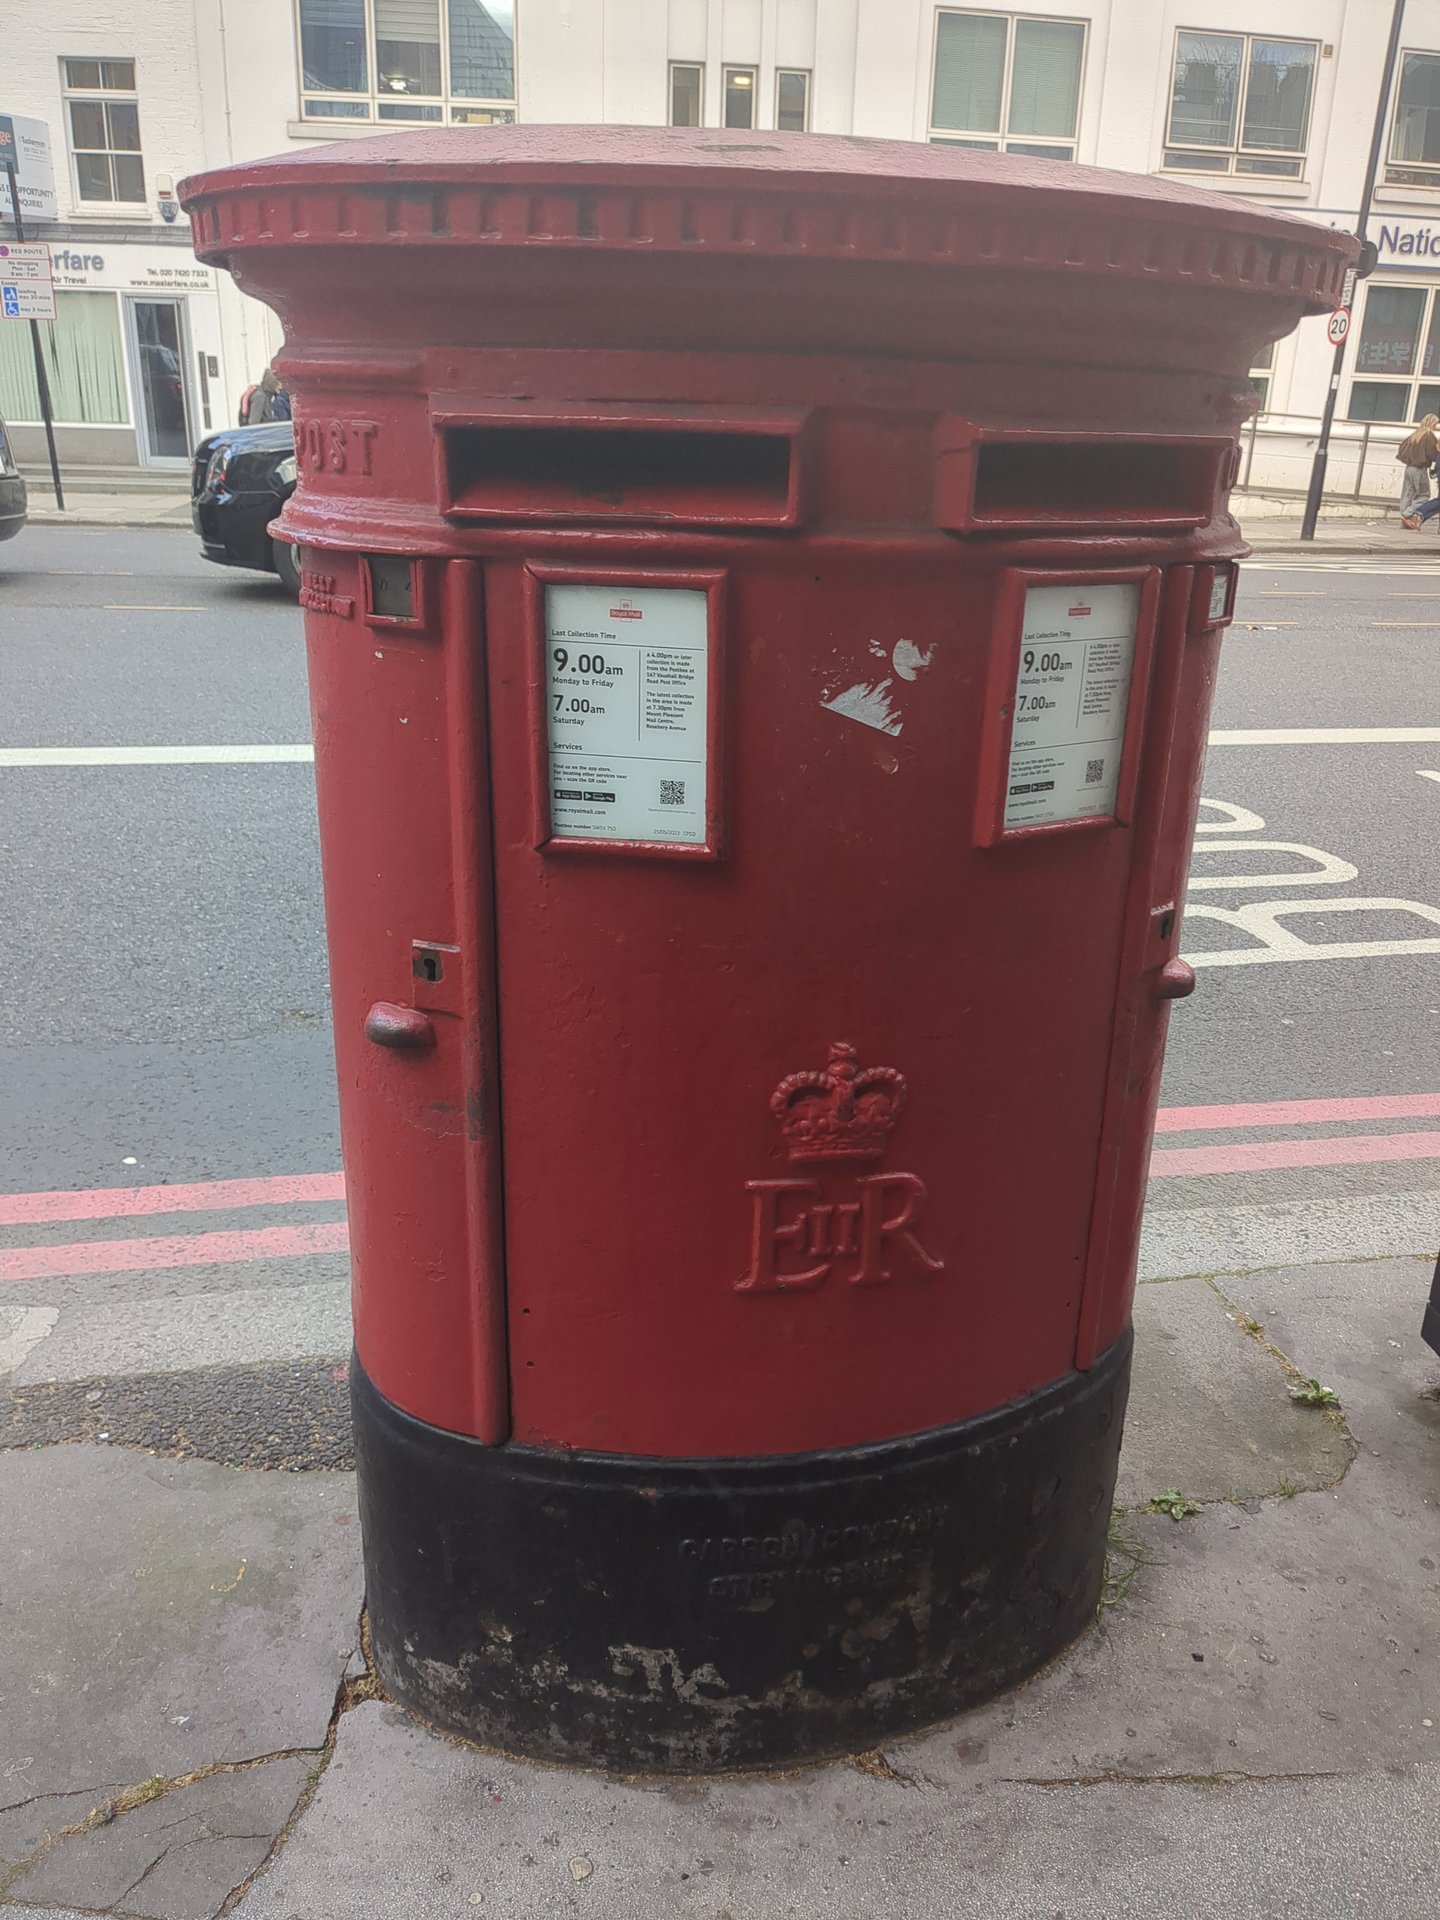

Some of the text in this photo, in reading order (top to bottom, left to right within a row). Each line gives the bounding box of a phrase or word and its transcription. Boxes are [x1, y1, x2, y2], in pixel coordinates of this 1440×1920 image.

[50, 250, 104, 271] rfare
[174, 269, 190, 277] 7420
[63, 276, 87, 284] Travel
[1330, 318, 1347, 335] 20
[552, 629, 616, 640] Last Collection Time
[553, 648, 623, 676] 9.00am
[1023, 650, 1072, 673] 9.00am
[552, 677, 614, 688] Monday to Friday
[1020, 677, 1040, 685] Monday
[553, 694, 605, 714] 7.00am
[1019, 695, 1056, 711] 7.00am
[553, 716, 585, 726] Saturday
[553, 742, 582, 751] Services
[1014, 739, 1036, 748] Services
